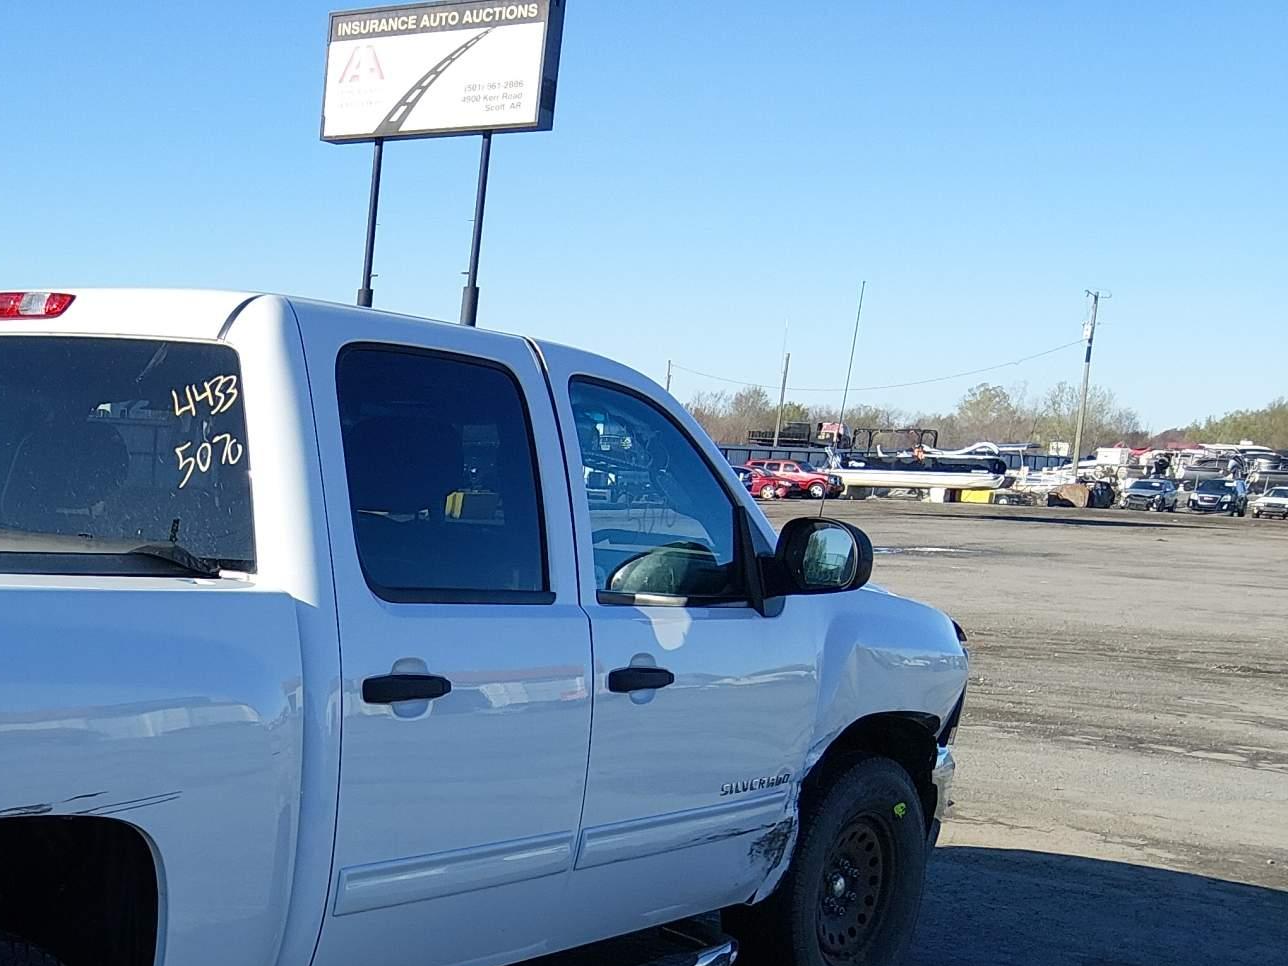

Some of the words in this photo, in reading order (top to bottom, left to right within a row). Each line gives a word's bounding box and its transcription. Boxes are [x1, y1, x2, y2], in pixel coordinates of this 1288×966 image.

[337, 15, 417, 36] INSURANCE
[419, 11, 459, 28] AUTO
[462, 3, 538, 24] AUCTIONS
[172, 375, 238, 417] 4433
[174, 433, 243, 489] 5070
[719, 773, 791, 797] SILVERADO
